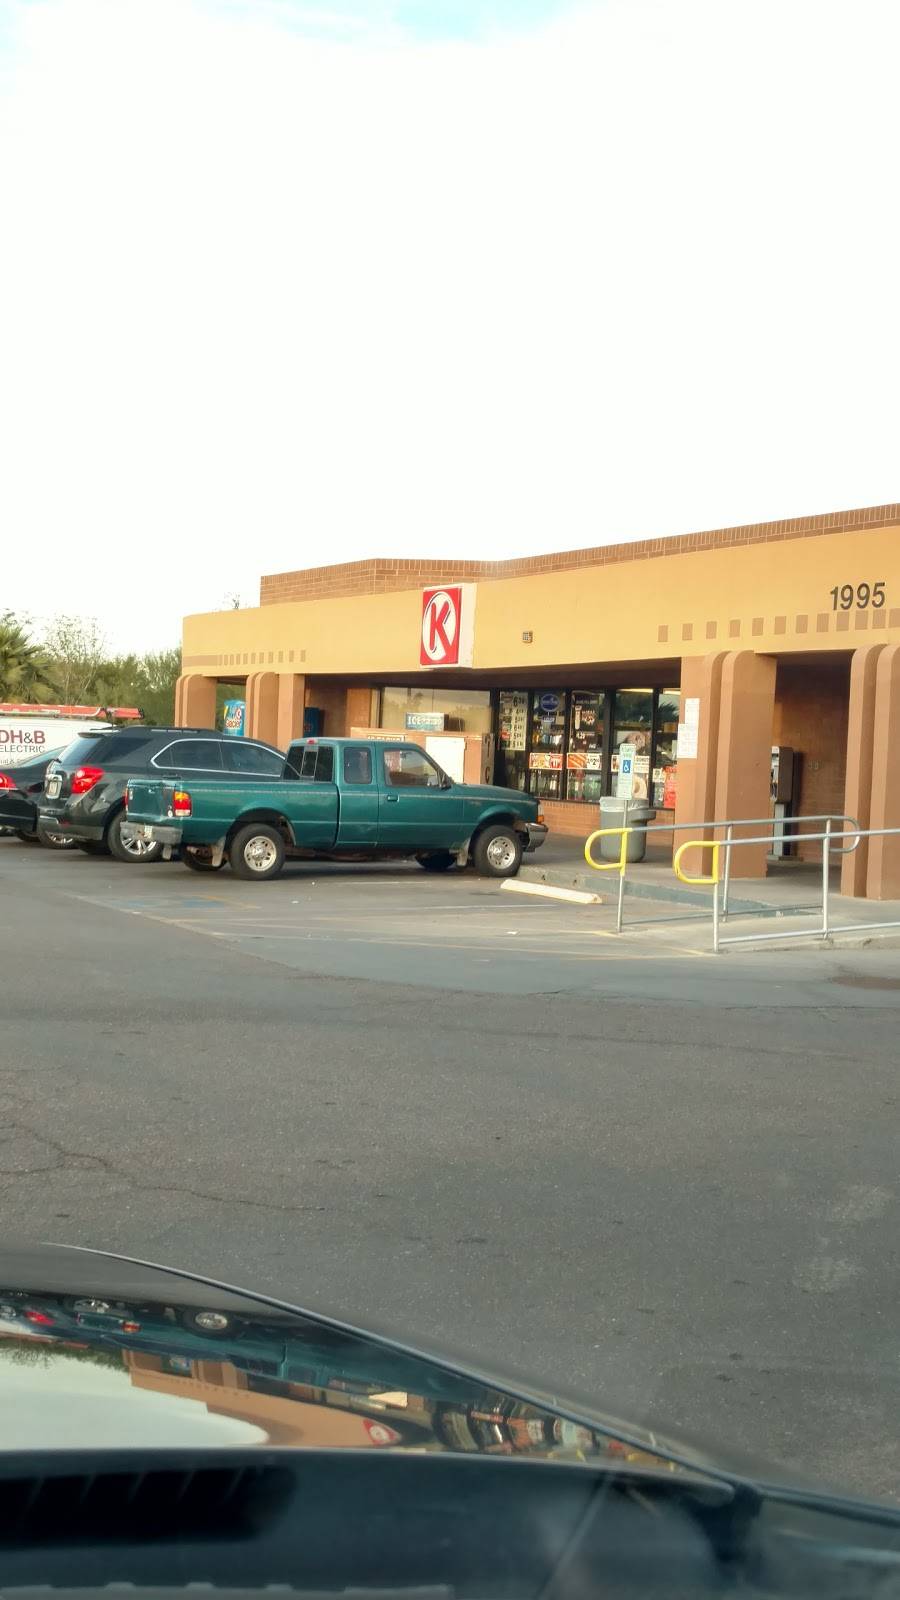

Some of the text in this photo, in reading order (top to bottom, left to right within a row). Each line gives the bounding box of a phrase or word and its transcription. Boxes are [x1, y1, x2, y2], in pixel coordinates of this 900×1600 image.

[830, 582, 886, 611] 1995
[429, 600, 453, 654] K
[0, 730, 46, 744] DH&B
[0, 744, 46, 753] ELECTRIC
